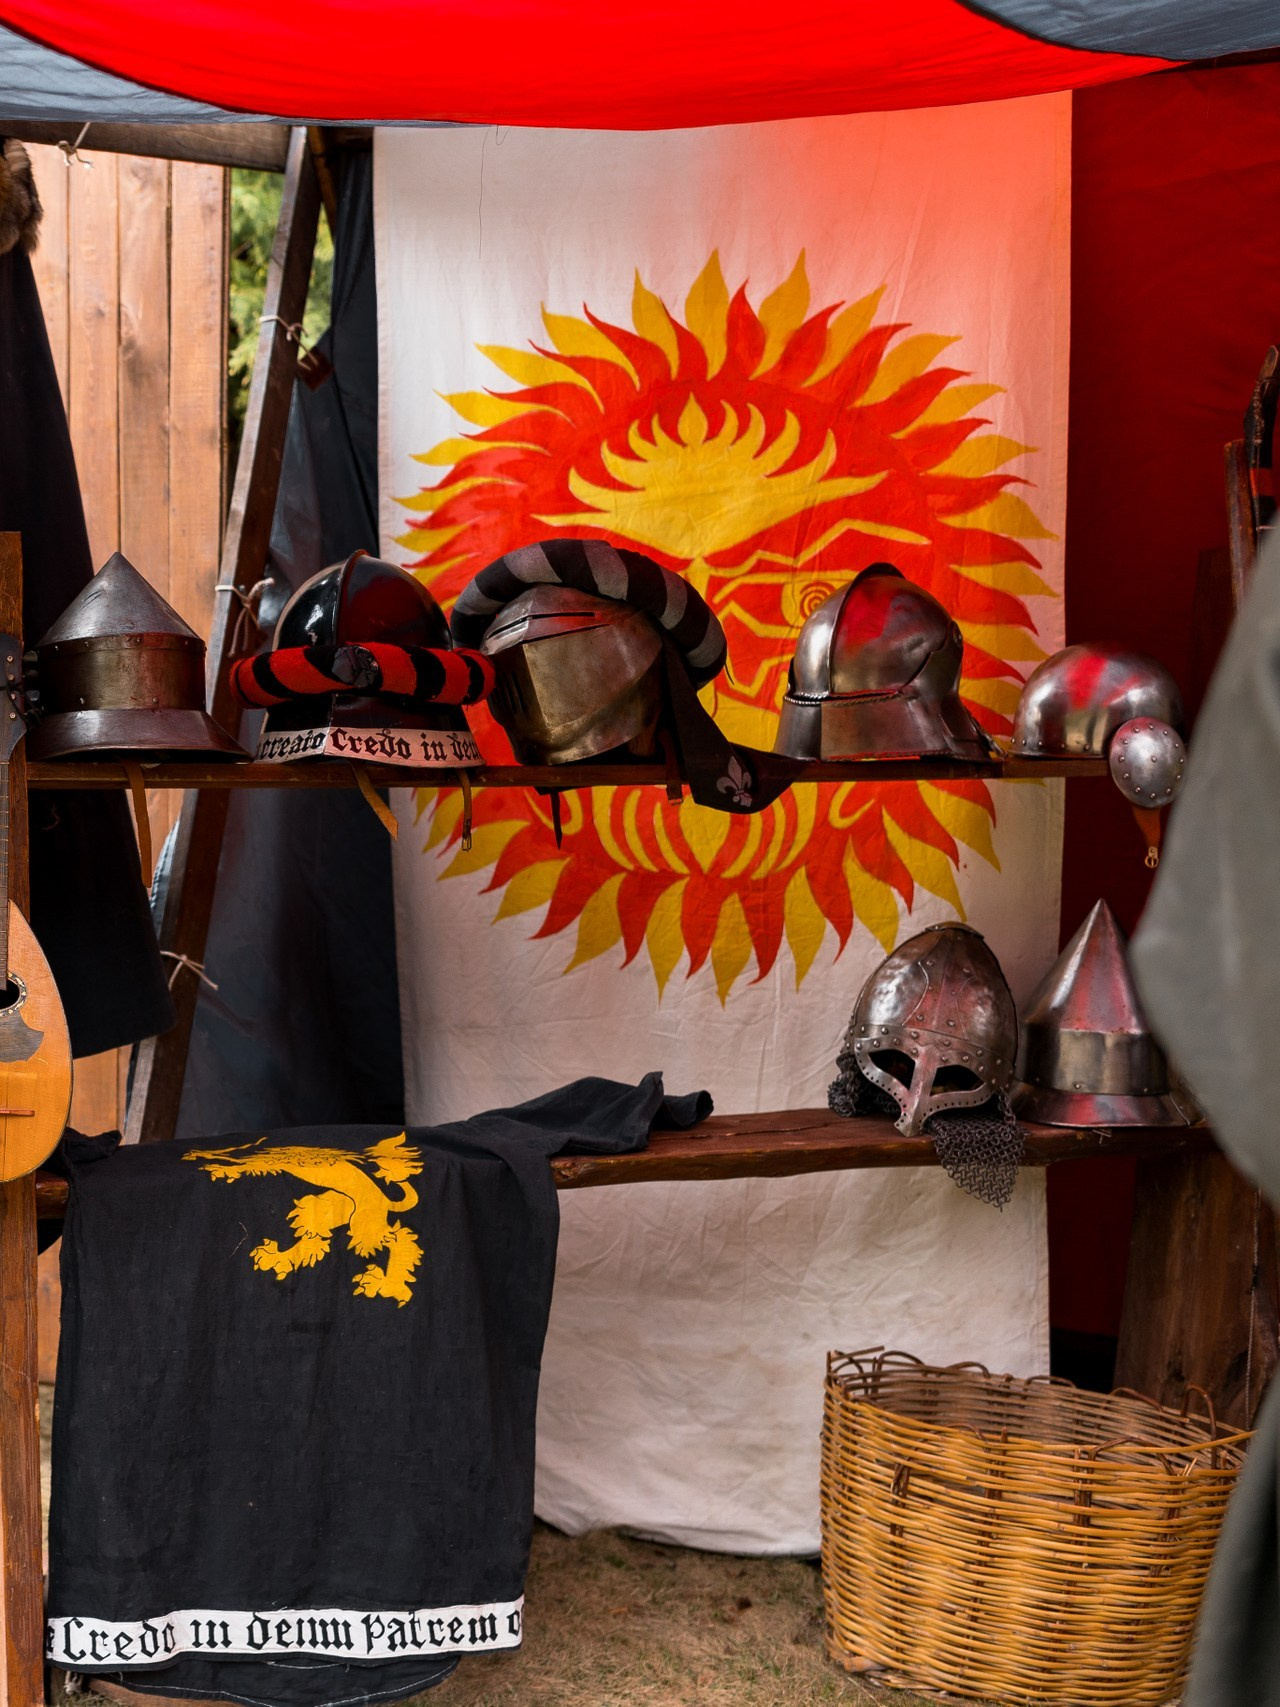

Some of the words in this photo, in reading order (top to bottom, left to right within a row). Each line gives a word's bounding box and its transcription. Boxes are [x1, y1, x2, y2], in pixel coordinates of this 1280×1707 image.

[330, 727, 413, 761] Credo
[420, 733, 448, 761] in
[62, 1616, 177, 1663] Credo
[360, 1611, 499, 1655] Patrem
